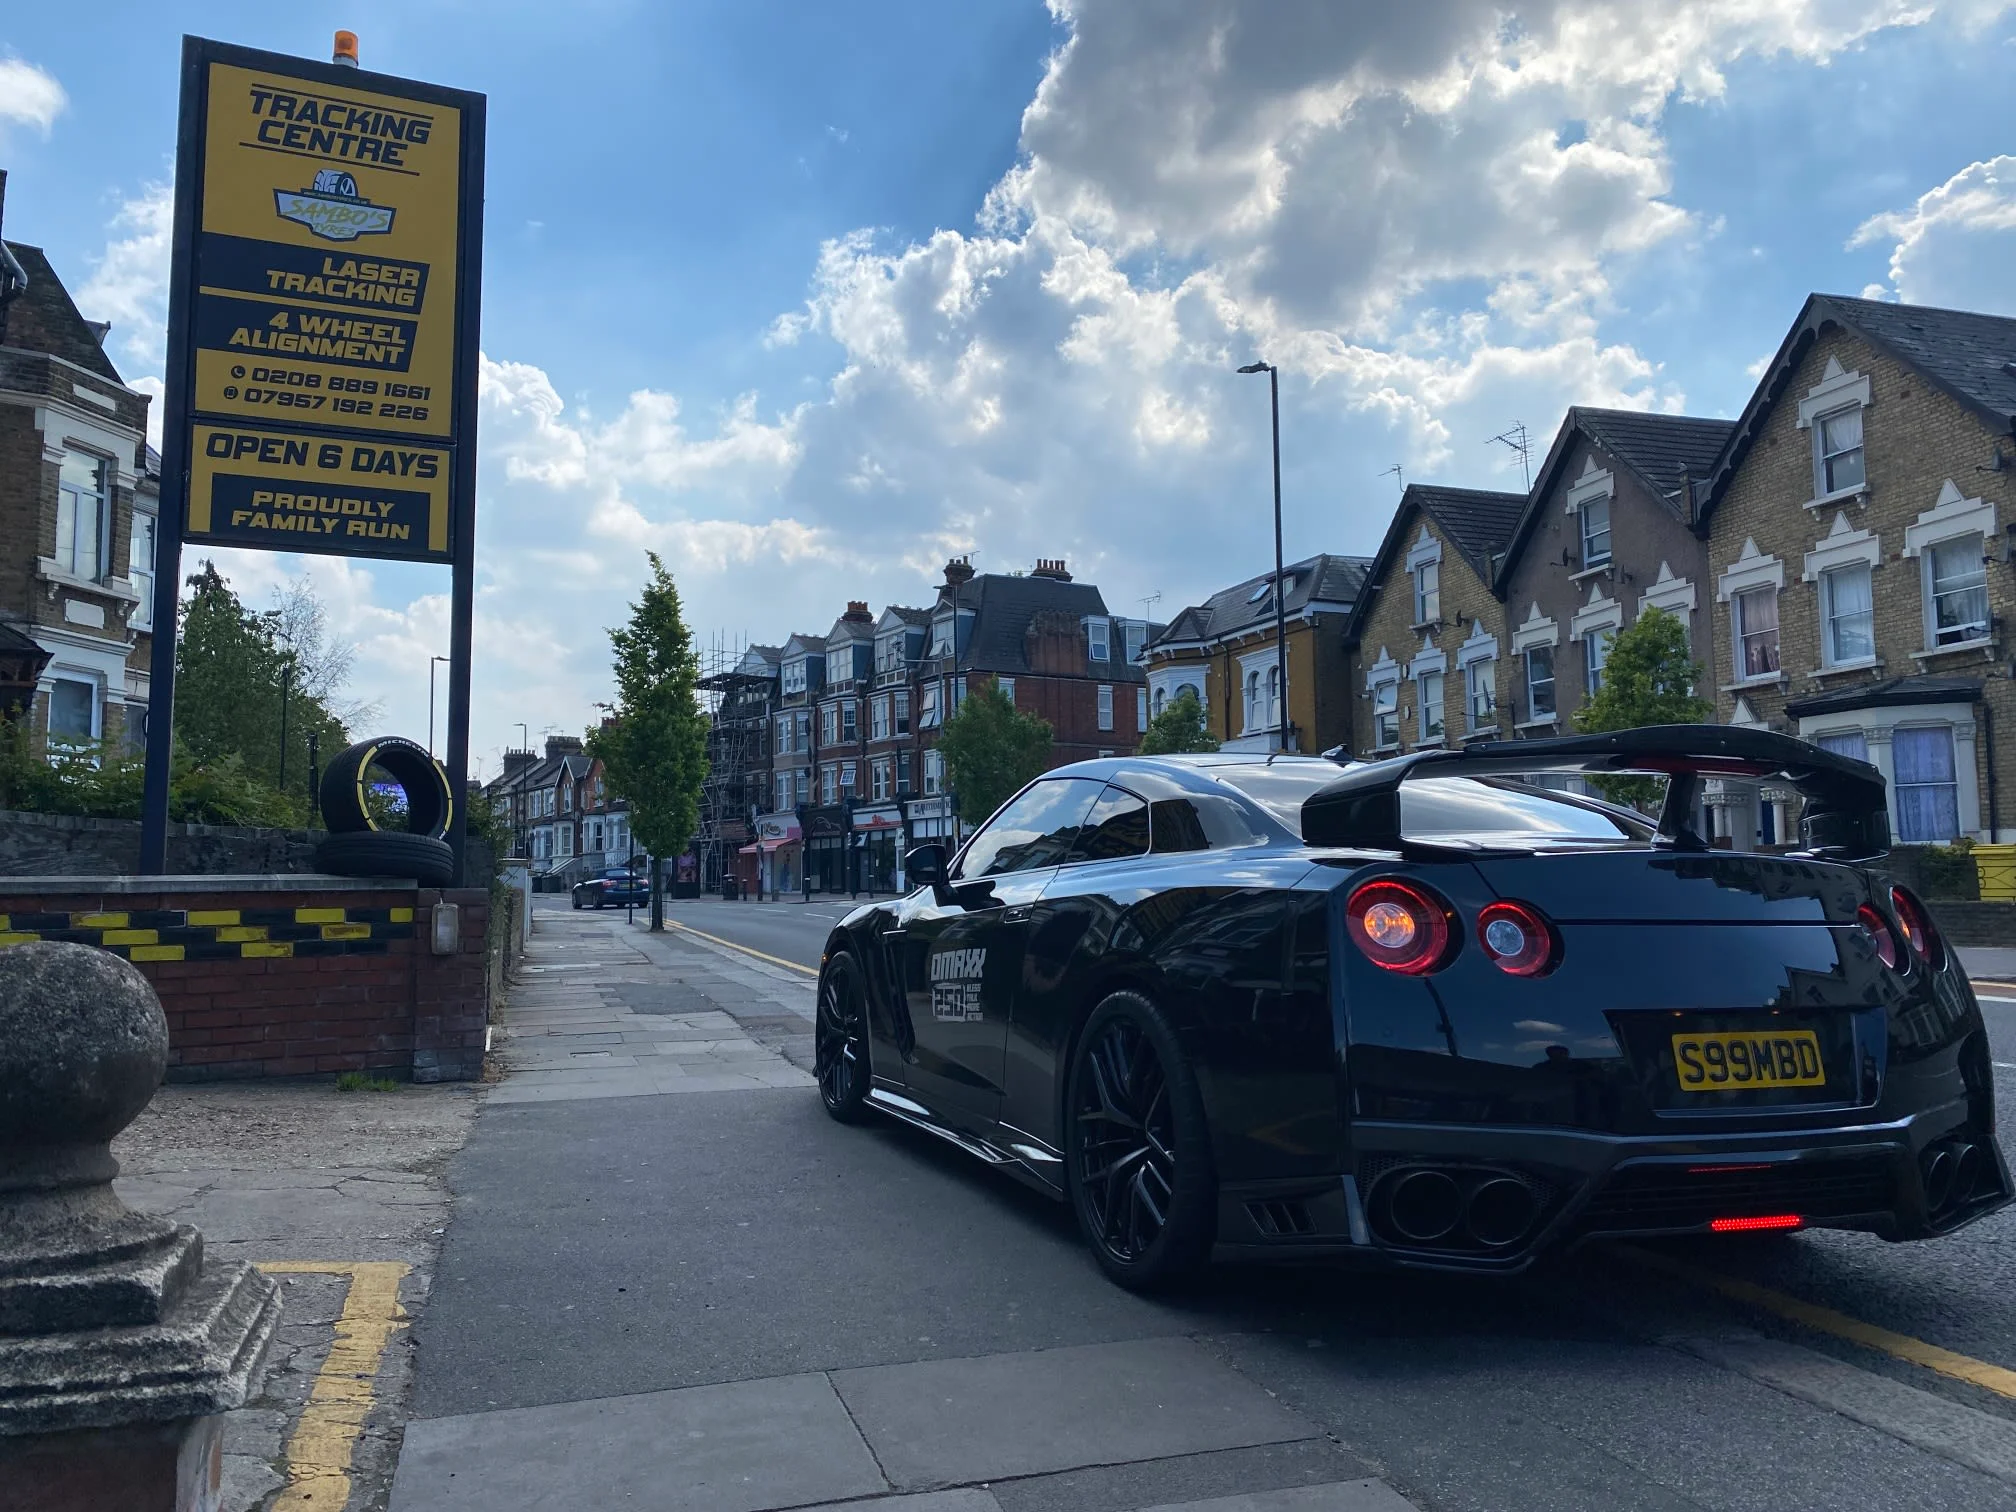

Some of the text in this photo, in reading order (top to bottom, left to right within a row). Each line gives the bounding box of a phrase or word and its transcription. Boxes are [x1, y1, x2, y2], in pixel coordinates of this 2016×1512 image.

[250, 90, 432, 144] TRACKING
[257, 120, 408, 166] CENTRE
[283, 199, 389, 228] SAMBO'S
[312, 223, 356, 237] TYRES
[322, 257, 420, 287] LASER
[266, 270, 417, 307] TRACKING
[269, 312, 407, 344] 4 WHEEL
[229, 328, 405, 364] ALIGNMENT
[252, 368, 431, 400] 0208 889 1661
[244, 388, 429, 421] 07957 192 226
[206, 433, 438, 479] OPEN 6 DAYS
[251, 490, 395, 518] PROUDLY
[231, 510, 411, 539] FAMILY RUN
[378, 740, 429, 757] MICHELIN
[1679, 1038, 1820, 1083] S99MBD
